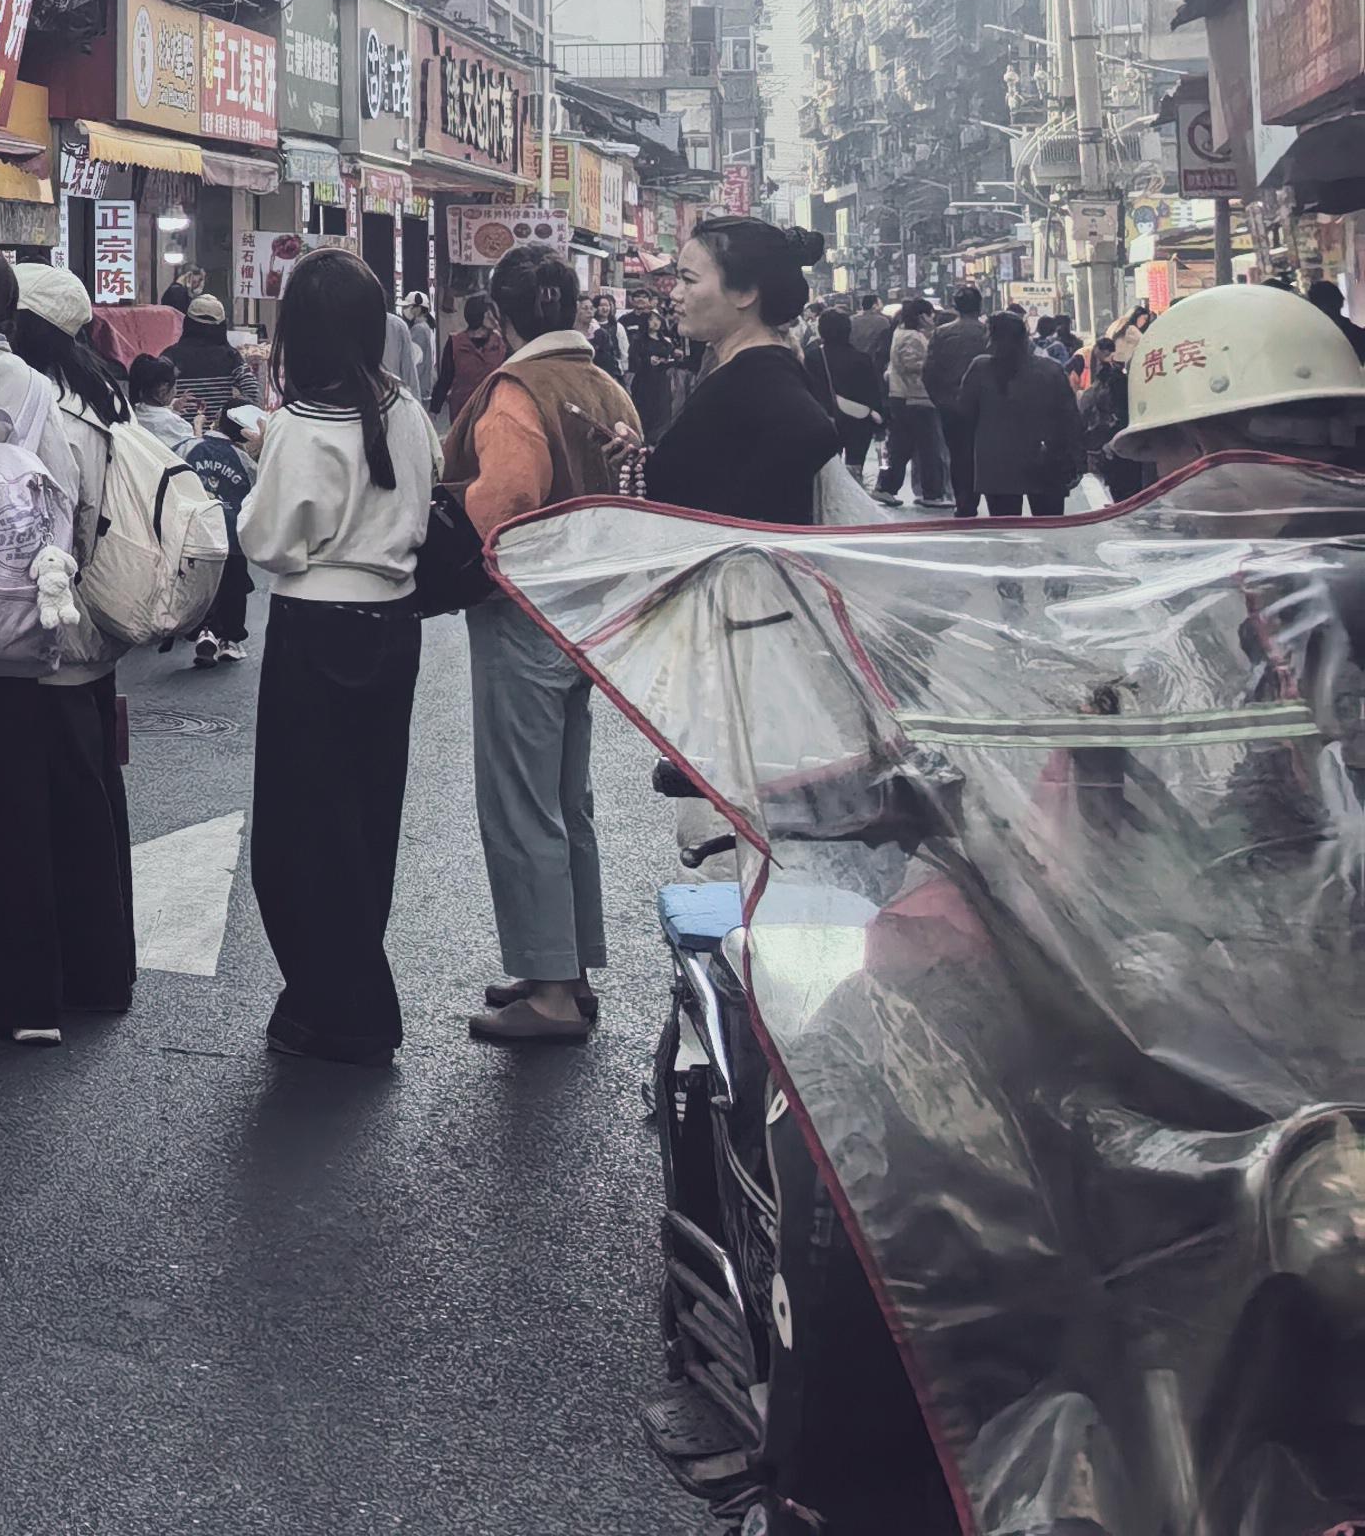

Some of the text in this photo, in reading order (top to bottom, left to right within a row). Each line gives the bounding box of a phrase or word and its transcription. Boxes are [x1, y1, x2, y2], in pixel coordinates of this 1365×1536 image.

[240, 233, 256, 295] 纯石榴汁
[1141, 338, 1207, 383] 贵宾
